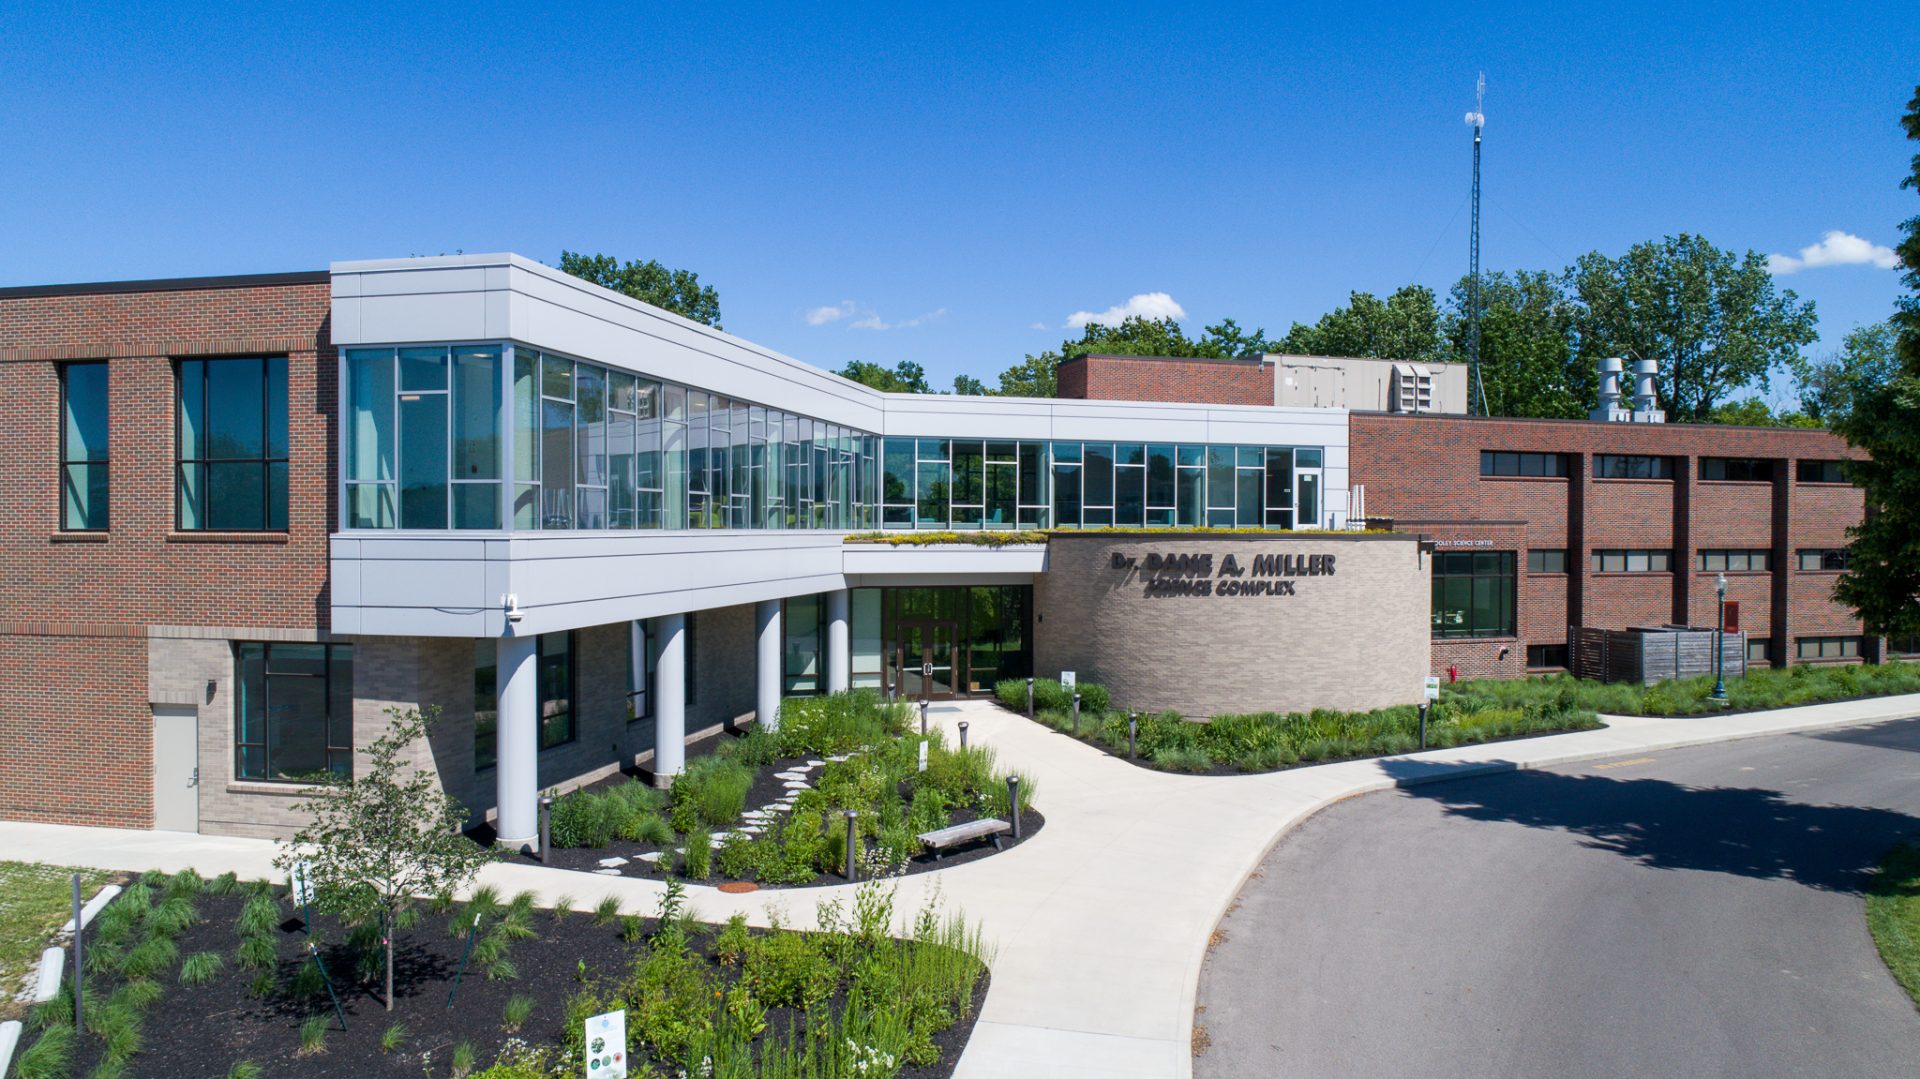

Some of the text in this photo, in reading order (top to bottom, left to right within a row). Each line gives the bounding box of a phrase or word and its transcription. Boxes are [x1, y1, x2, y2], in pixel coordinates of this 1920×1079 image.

[1111, 552, 1336, 576] Dr. DANE A. MILLER
[1147, 579, 1297, 597] SCIENCE COMPLEX
